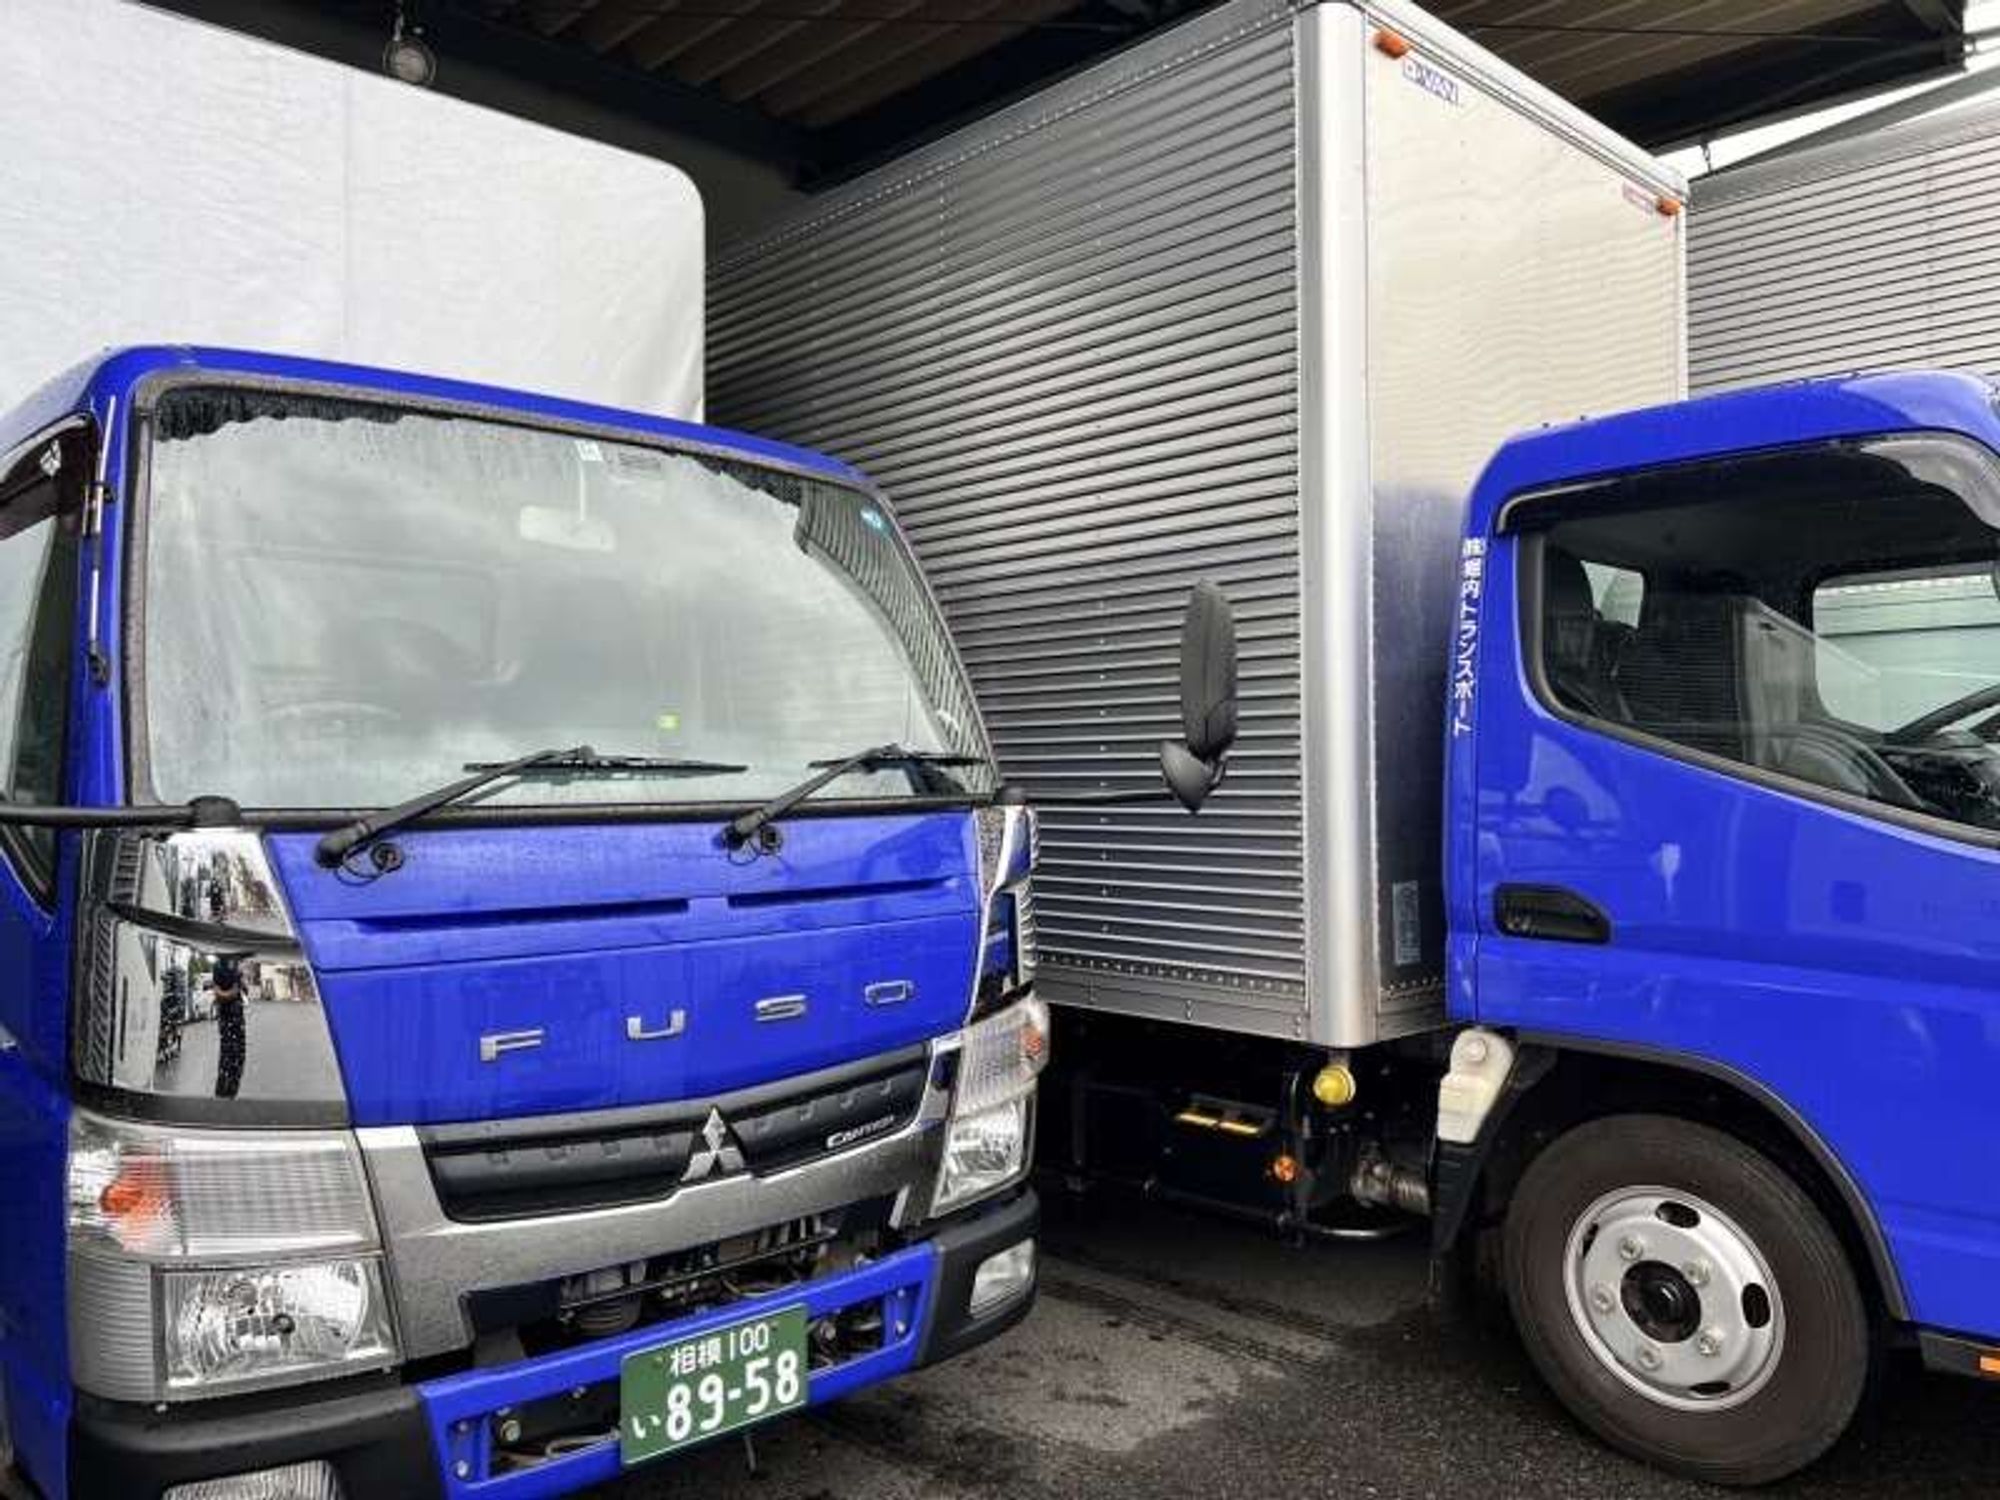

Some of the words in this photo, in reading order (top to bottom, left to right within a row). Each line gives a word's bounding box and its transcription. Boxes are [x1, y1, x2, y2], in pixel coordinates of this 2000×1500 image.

[480, 979, 915, 1062] FUSO
[669, 1337, 722, 1378] 相模
[729, 1322, 770, 1360] 100
[632, 1414, 661, 1440] い
[666, 1349, 800, 1442] 89-58
